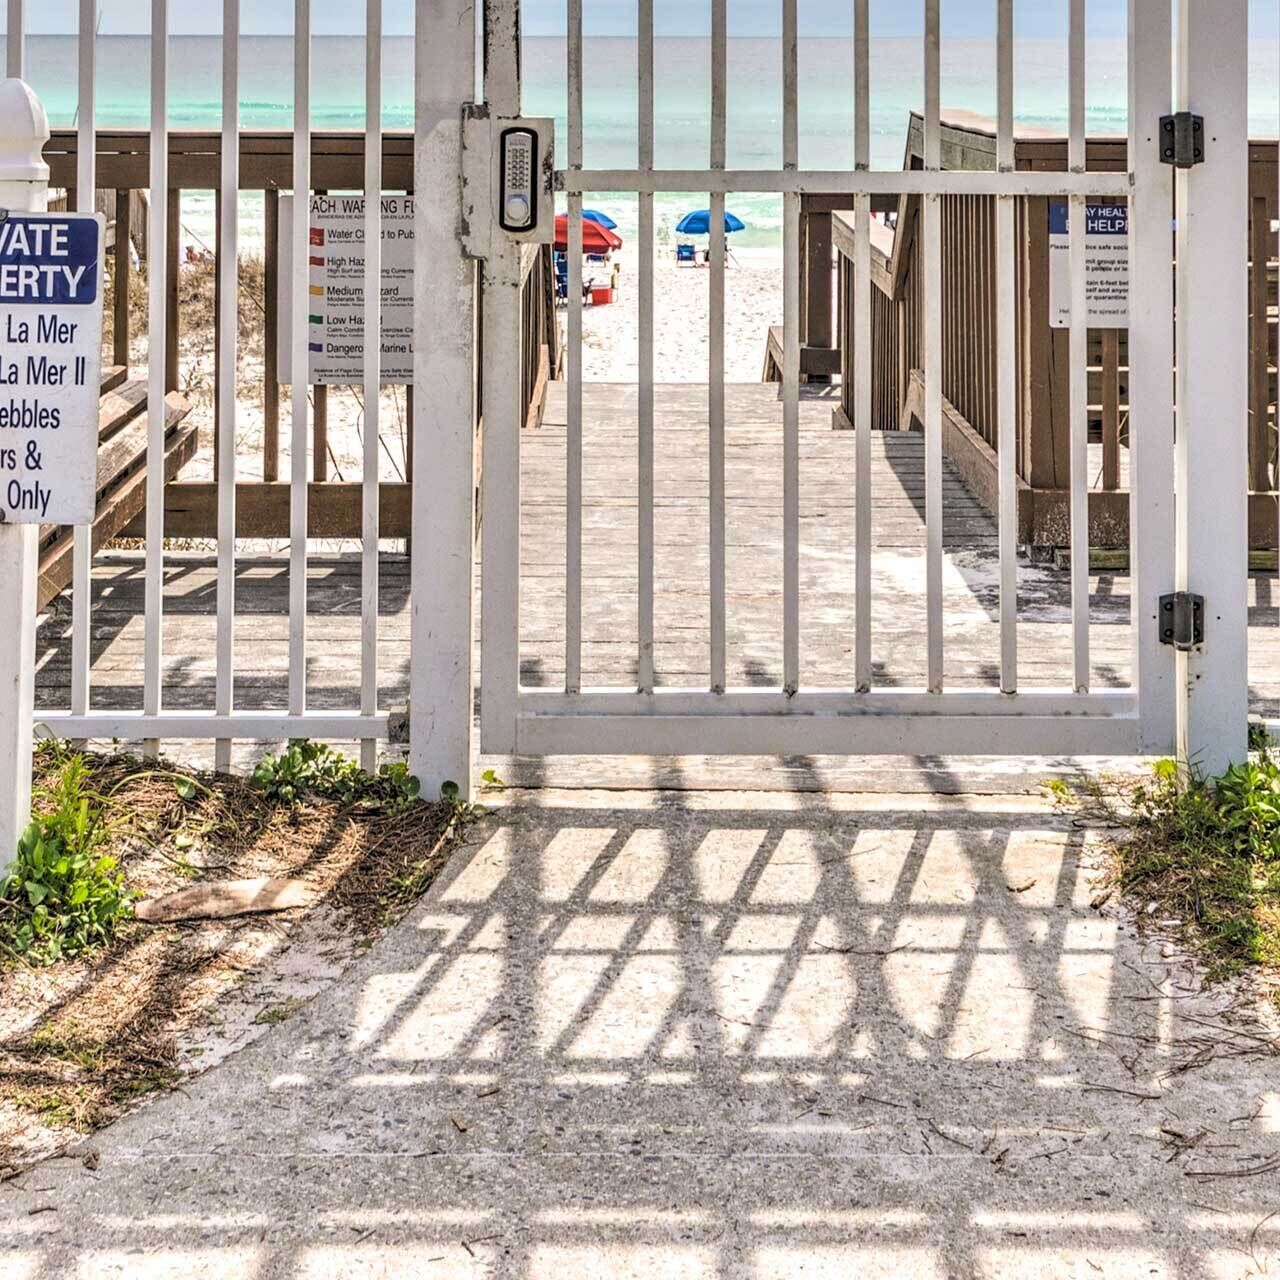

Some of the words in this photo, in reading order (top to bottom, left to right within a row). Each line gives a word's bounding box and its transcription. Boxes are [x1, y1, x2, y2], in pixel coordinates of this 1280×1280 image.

[310, 200, 336, 213] ACH
[342, 199, 398, 214] WARNG
[1088, 219, 1128, 232] HELP
[328, 229, 353, 239] Water
[355, 228, 384, 239] Cld
[387, 229, 396, 239] to
[398, 229, 414, 239] Pub
[327, 257, 346, 268] High
[349, 257, 365, 266] Haz
[327, 286, 363, 295] Medium
[381, 286, 399, 295] zard
[327, 315, 346, 325] Low
[7, 314, 28, 343] La
[37, 314, 78, 344] Mer
[327, 343, 364, 355] Dangero
[26, 356, 67, 385] Mer
[74, 356, 85, 385] II
[25, 439, 43, 471] &
[7, 479, 51, 517] Only
